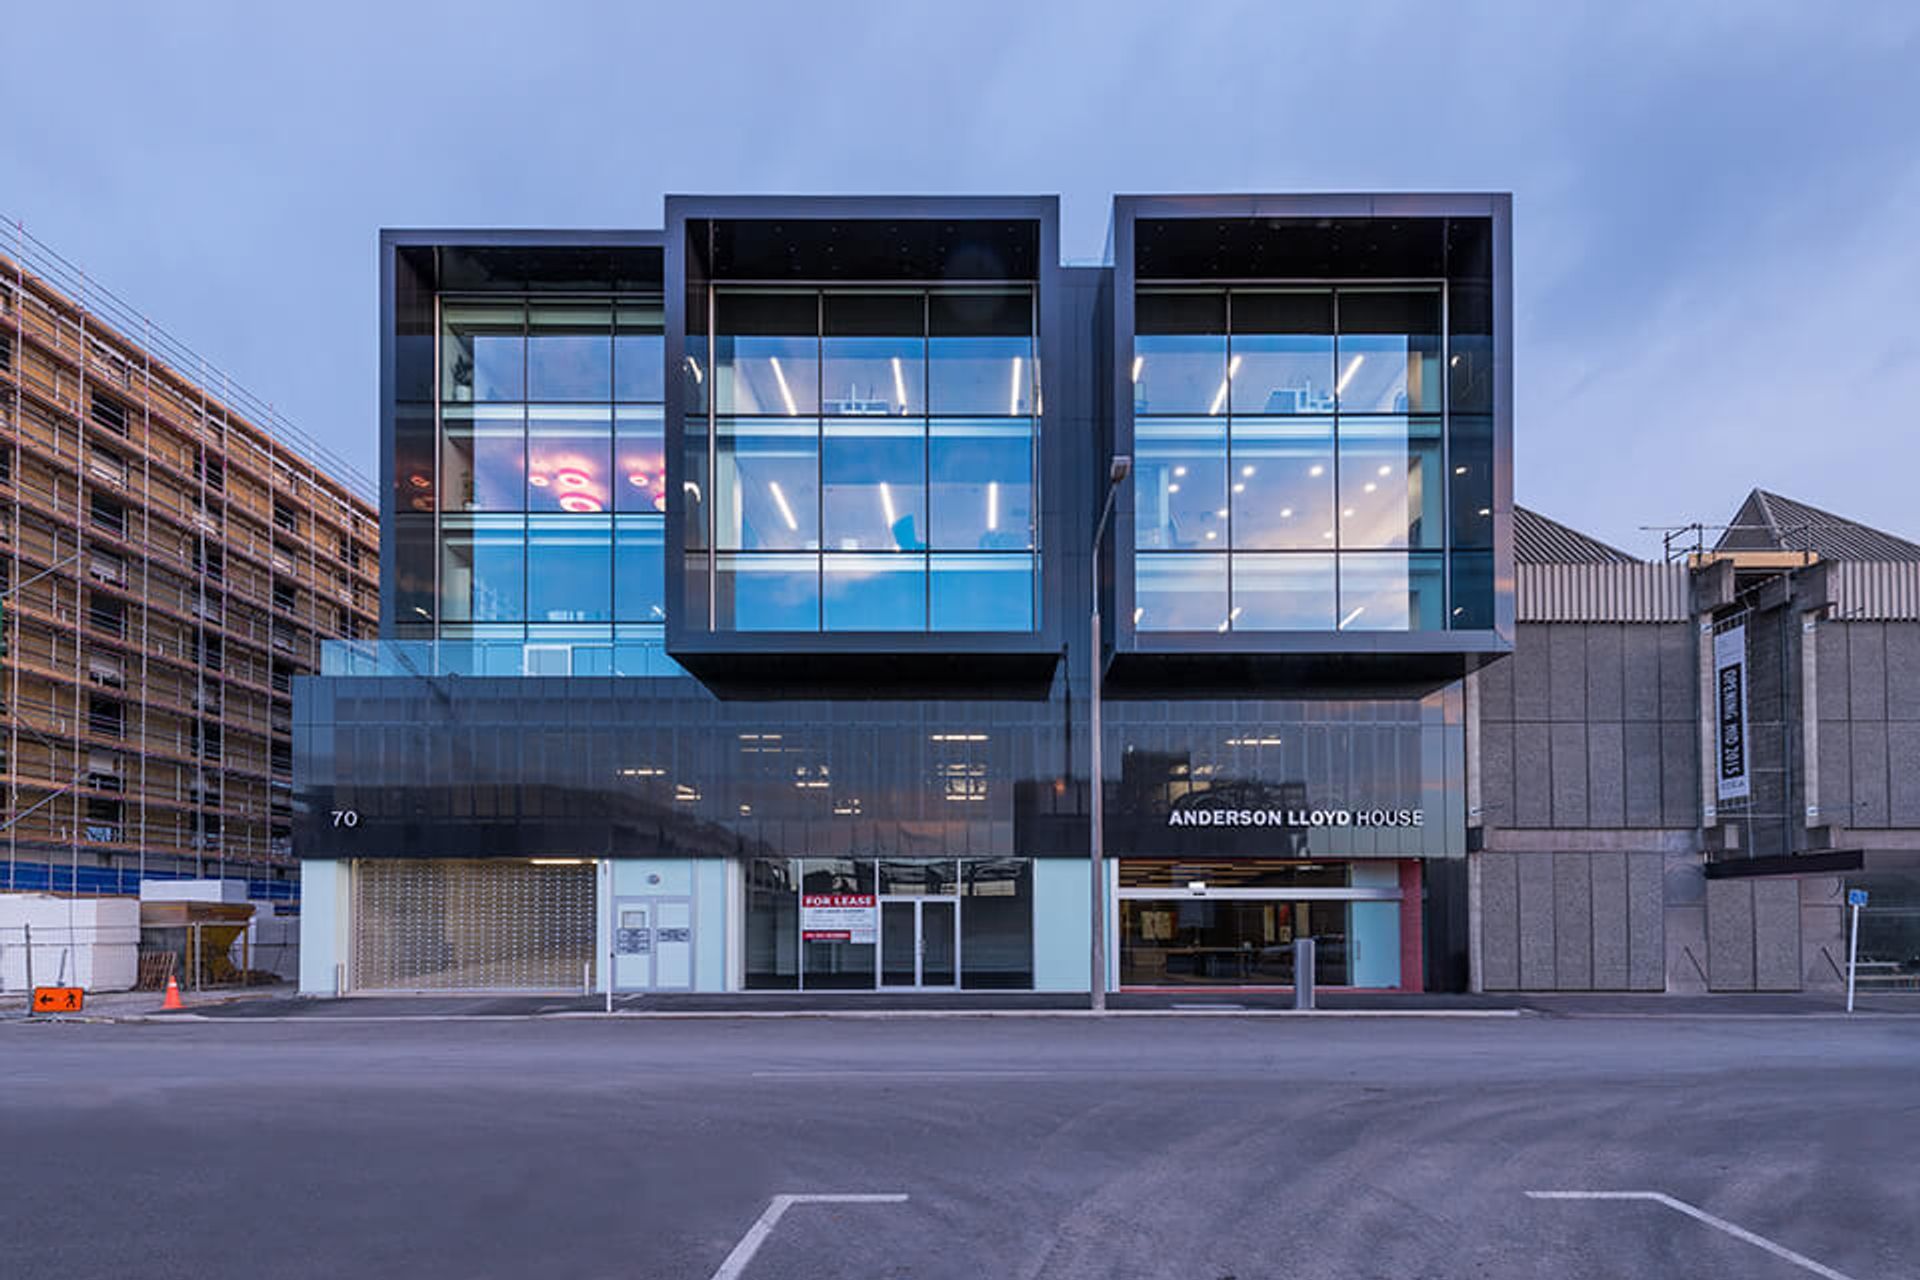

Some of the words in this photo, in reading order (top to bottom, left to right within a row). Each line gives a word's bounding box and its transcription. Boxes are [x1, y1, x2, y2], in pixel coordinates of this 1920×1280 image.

[1725, 746, 1740, 775] 2015
[330, 810, 357, 827] 70
[1168, 809, 1282, 826] ANDERSON
[1287, 809, 1351, 826] LLOYD
[1356, 809, 1424, 826] HOUSE
[805, 895, 831, 906] FOR
[834, 895, 872, 906] LEASE
